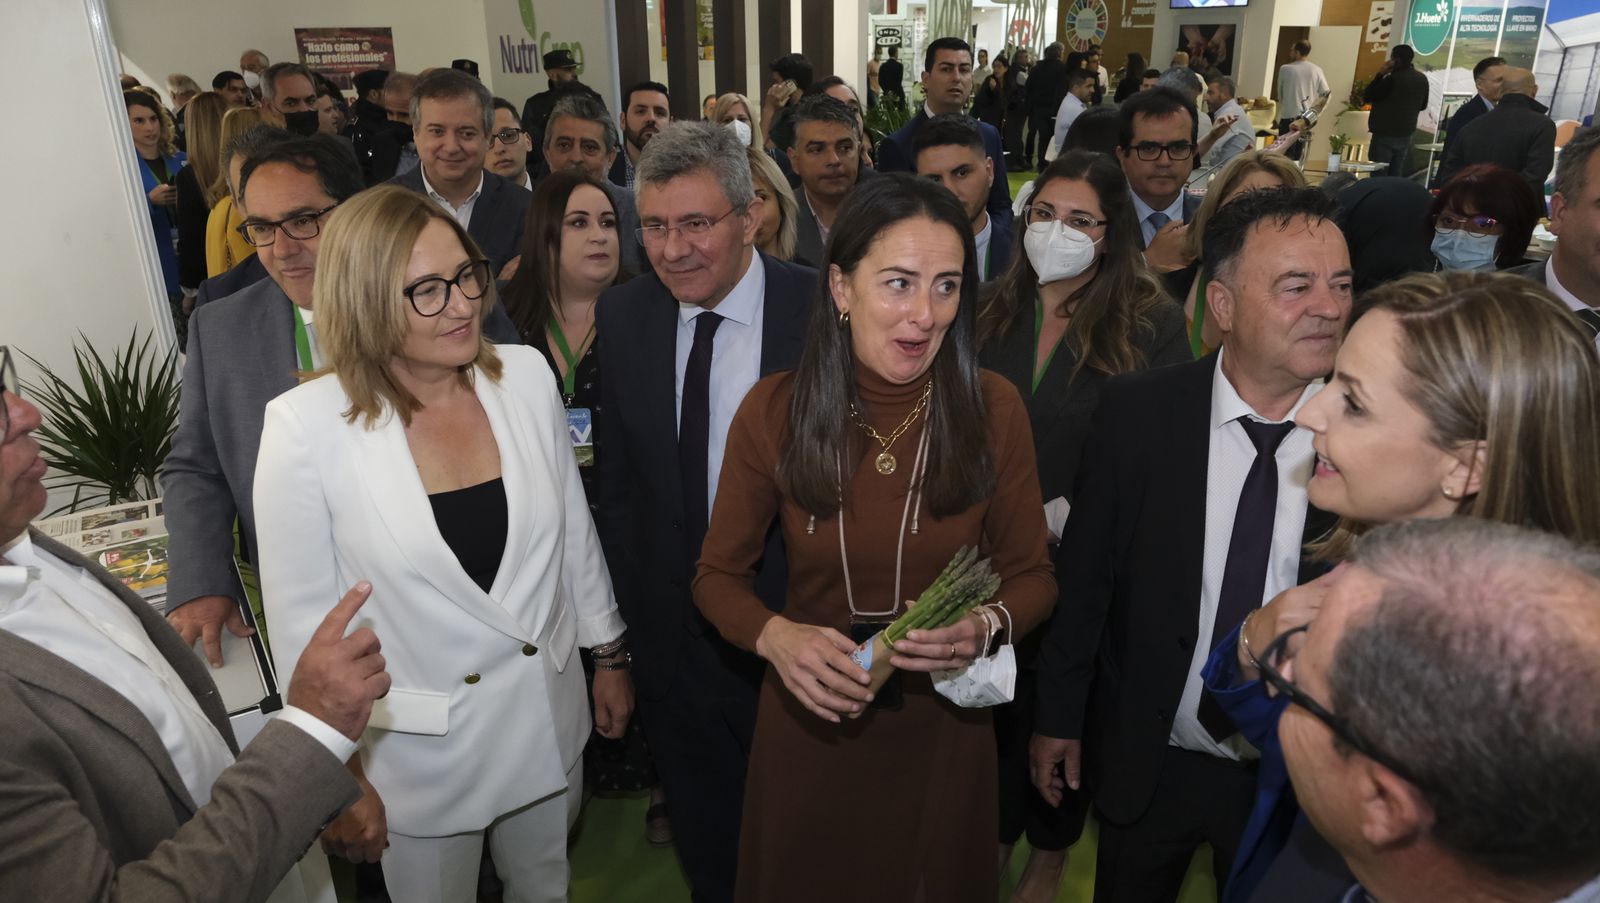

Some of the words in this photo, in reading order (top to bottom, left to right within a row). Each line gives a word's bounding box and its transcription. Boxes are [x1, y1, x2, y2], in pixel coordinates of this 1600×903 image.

[1459, 24, 1470, 32] ALTA
[334, 43, 360, 52] como
[305, 53, 320, 63] los
